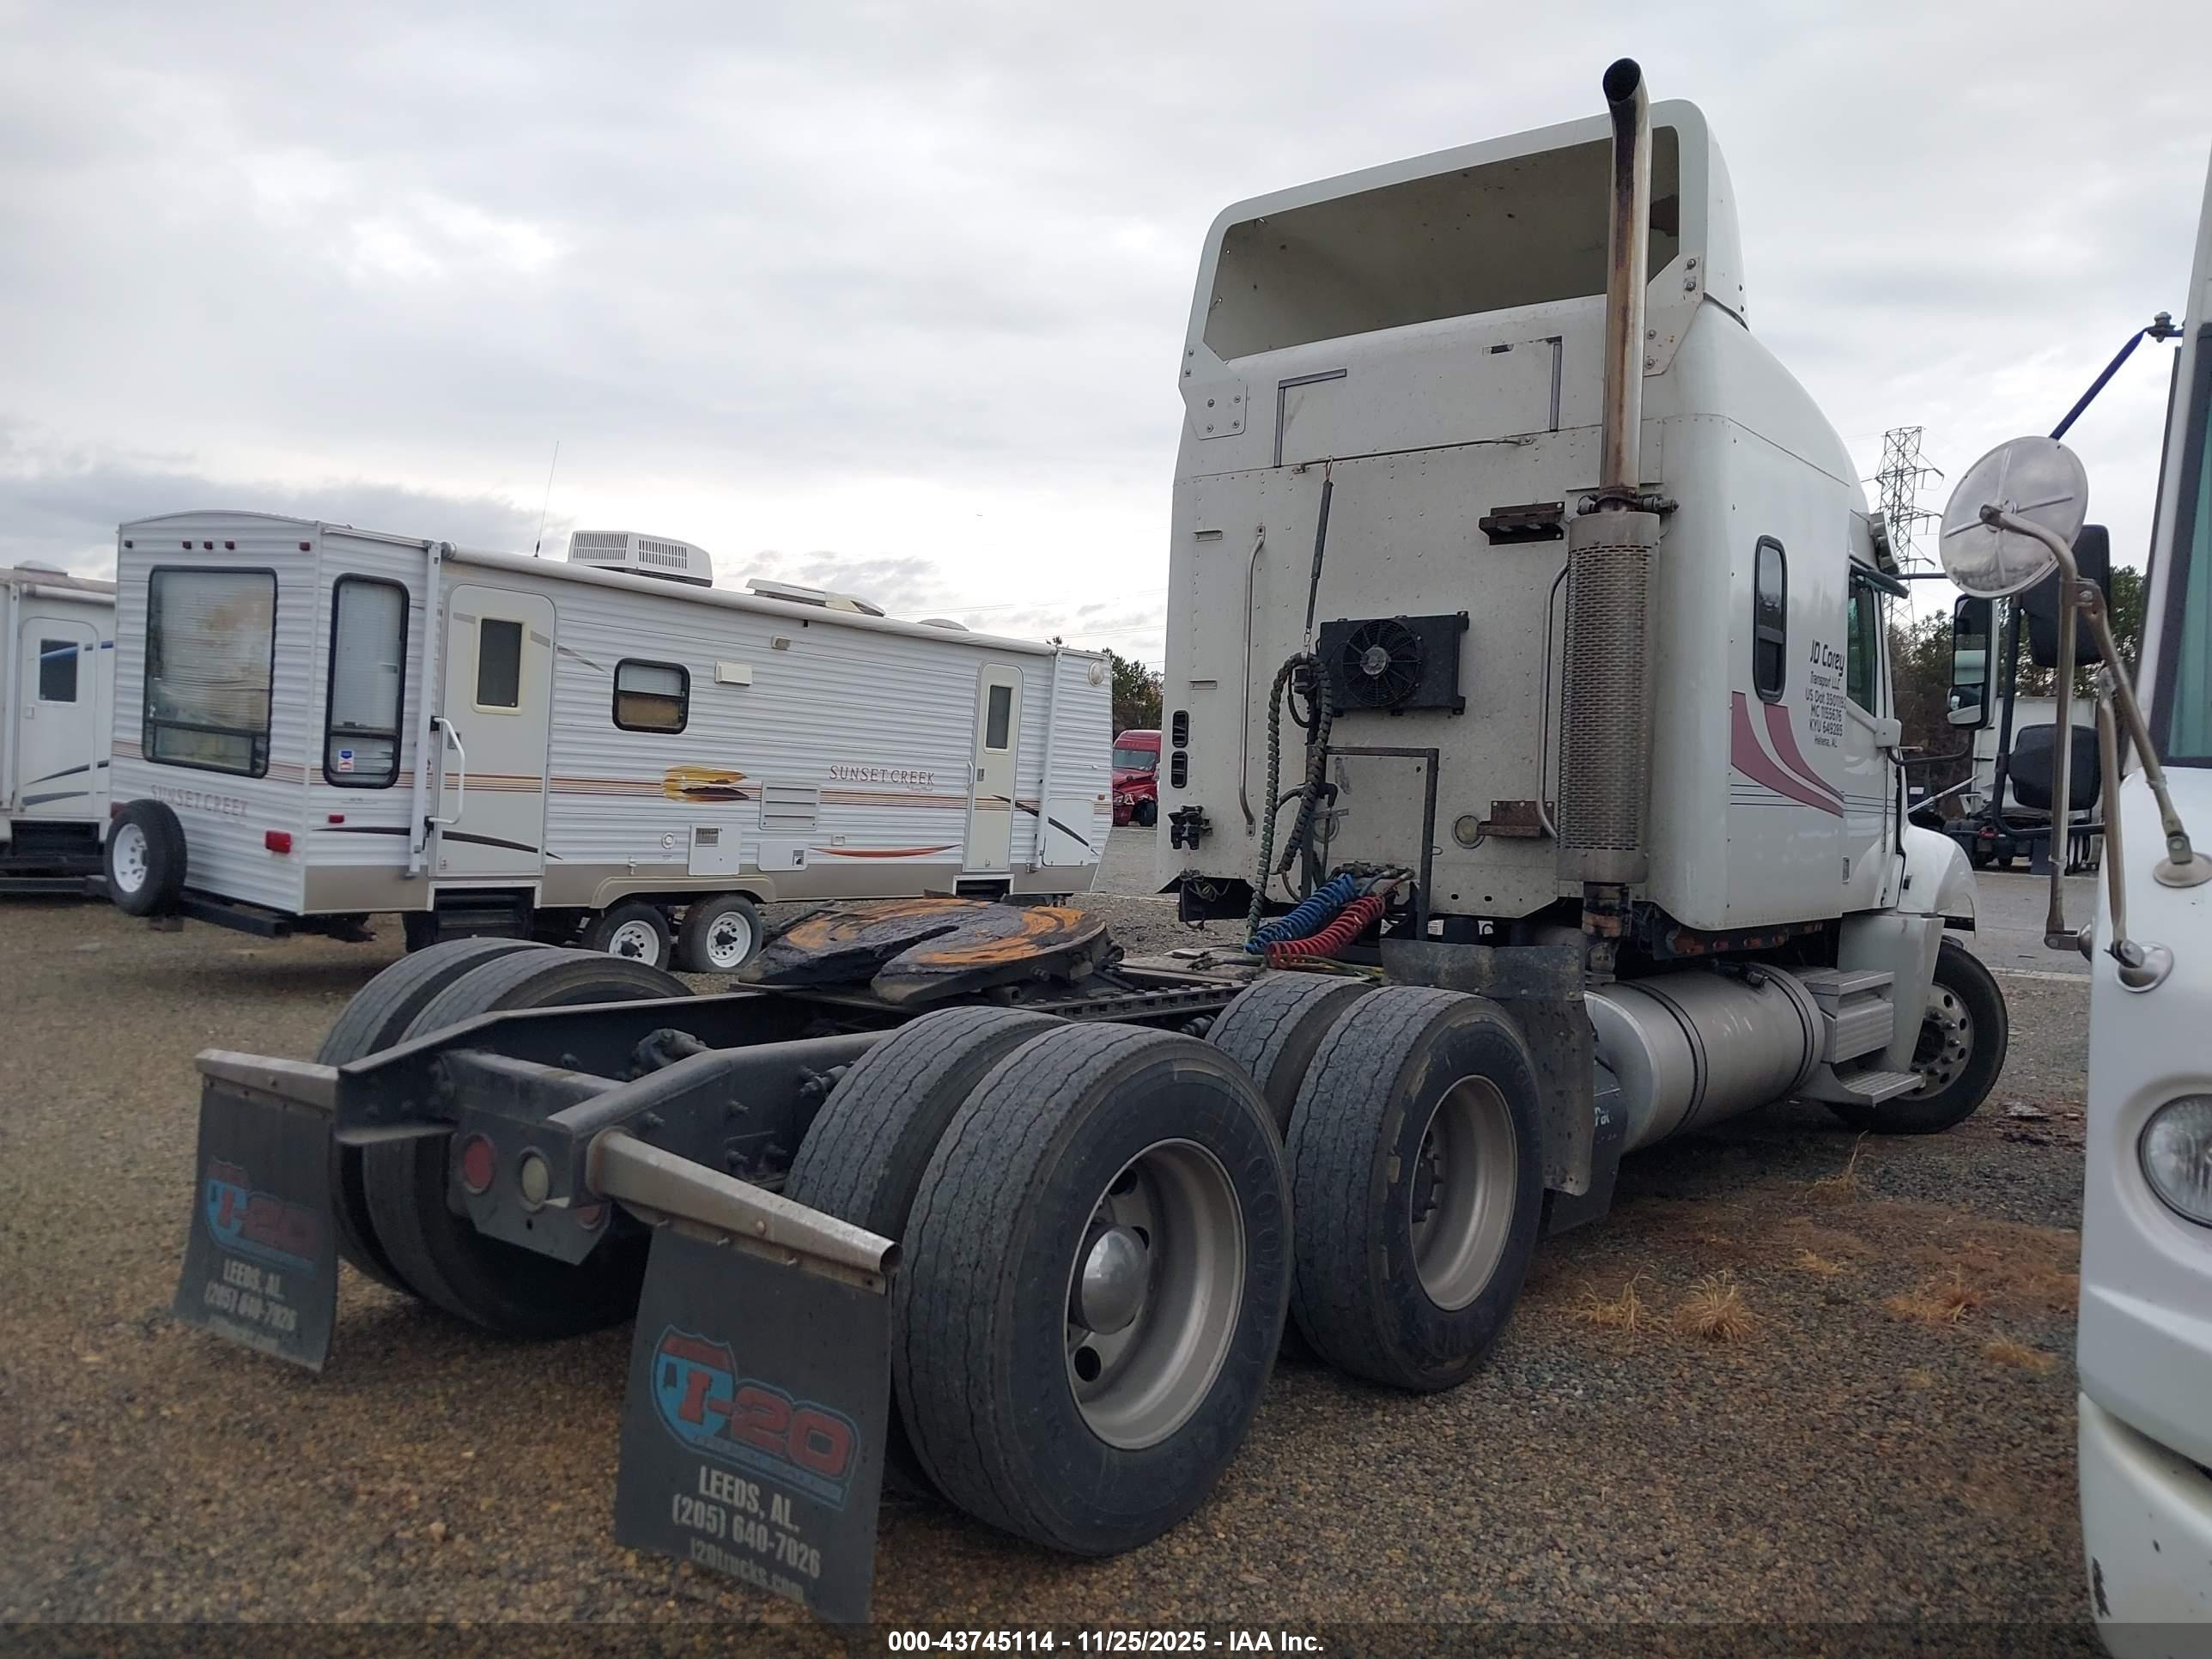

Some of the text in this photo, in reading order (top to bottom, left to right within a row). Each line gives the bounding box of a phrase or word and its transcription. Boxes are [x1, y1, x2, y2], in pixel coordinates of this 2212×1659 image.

[1810, 639, 1845, 678] JD Corey
[1810, 671, 1841, 690] Transport LLC
[1805, 687, 1814, 702] US
[1810, 703, 1820, 717] MC
[830, 764, 935, 785] SUNSET CREEK
[204, 793, 249, 817] CREEK
[678, 1370, 850, 1476] I-20
[698, 1464, 766, 1521] LEEDS,
[769, 1492, 801, 1533] AL.
[672, 1492, 822, 1580] (205) 640-7026
